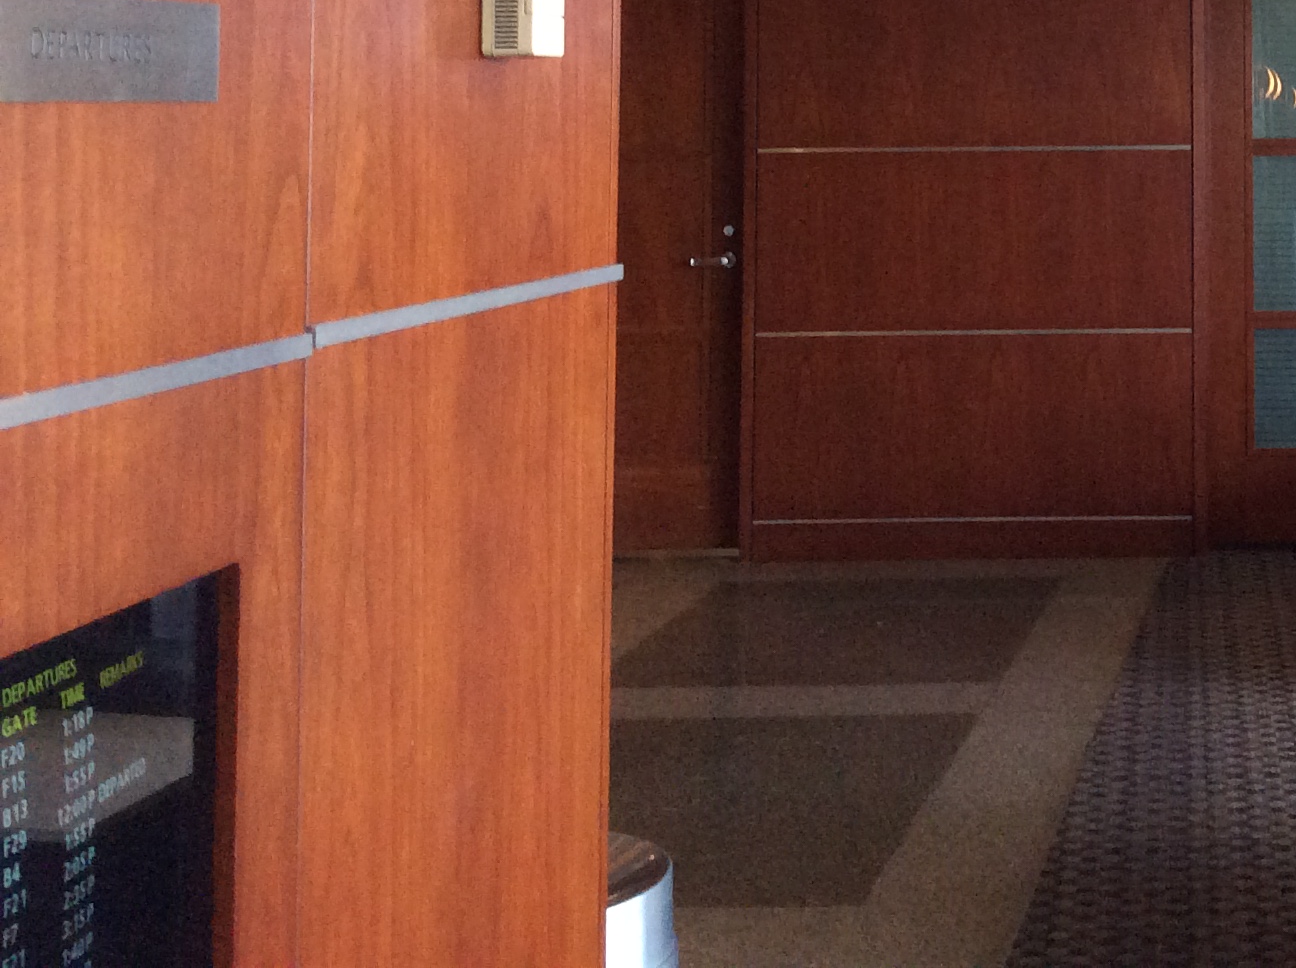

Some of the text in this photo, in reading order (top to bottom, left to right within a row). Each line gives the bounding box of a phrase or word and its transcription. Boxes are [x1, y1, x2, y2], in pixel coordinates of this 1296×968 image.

[30, 27, 152, 63] DEPARTURES
[1, 650, 145, 738] GATE TIME REMARKS
[2, 658, 77, 708] DEPARTURES
[2, 770, 26, 799] F15
